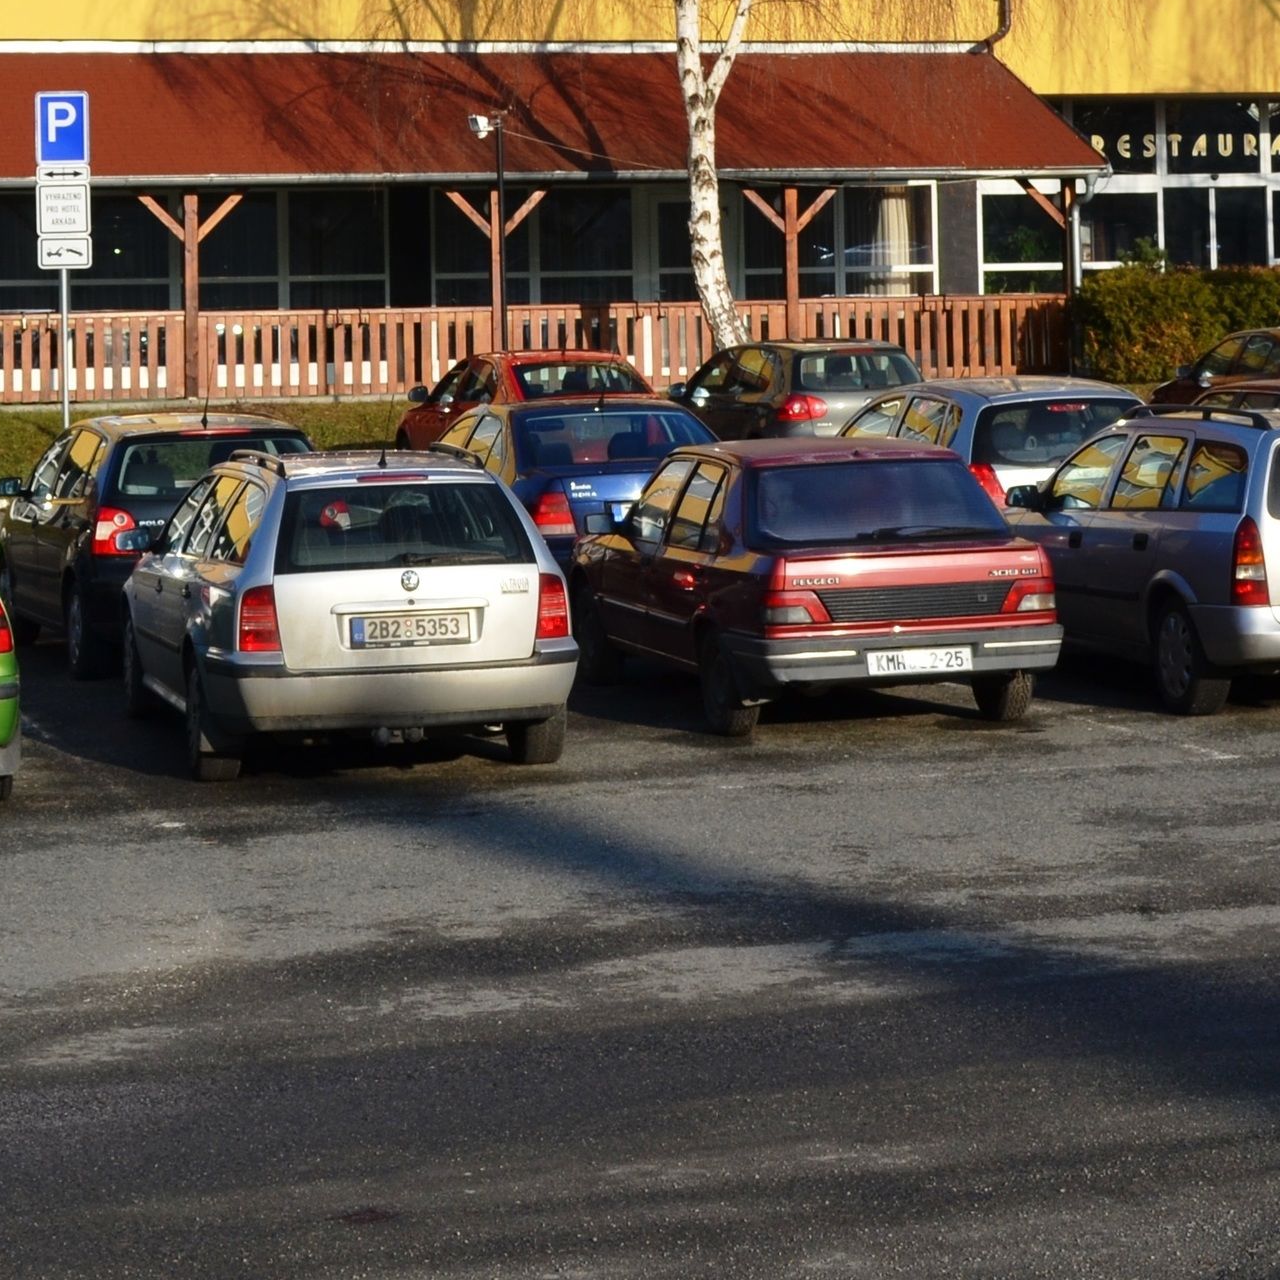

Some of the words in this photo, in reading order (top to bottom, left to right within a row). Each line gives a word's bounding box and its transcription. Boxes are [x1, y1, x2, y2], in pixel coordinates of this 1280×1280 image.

[47, 101, 77, 143] P
[45, 192, 82, 201] VYHRAZENO
[61, 204, 80, 213] HOTEL
[792, 576, 841, 587] PEUGEOT
[367, 620, 402, 640] 2B2
[415, 618, 460, 637] 5353
